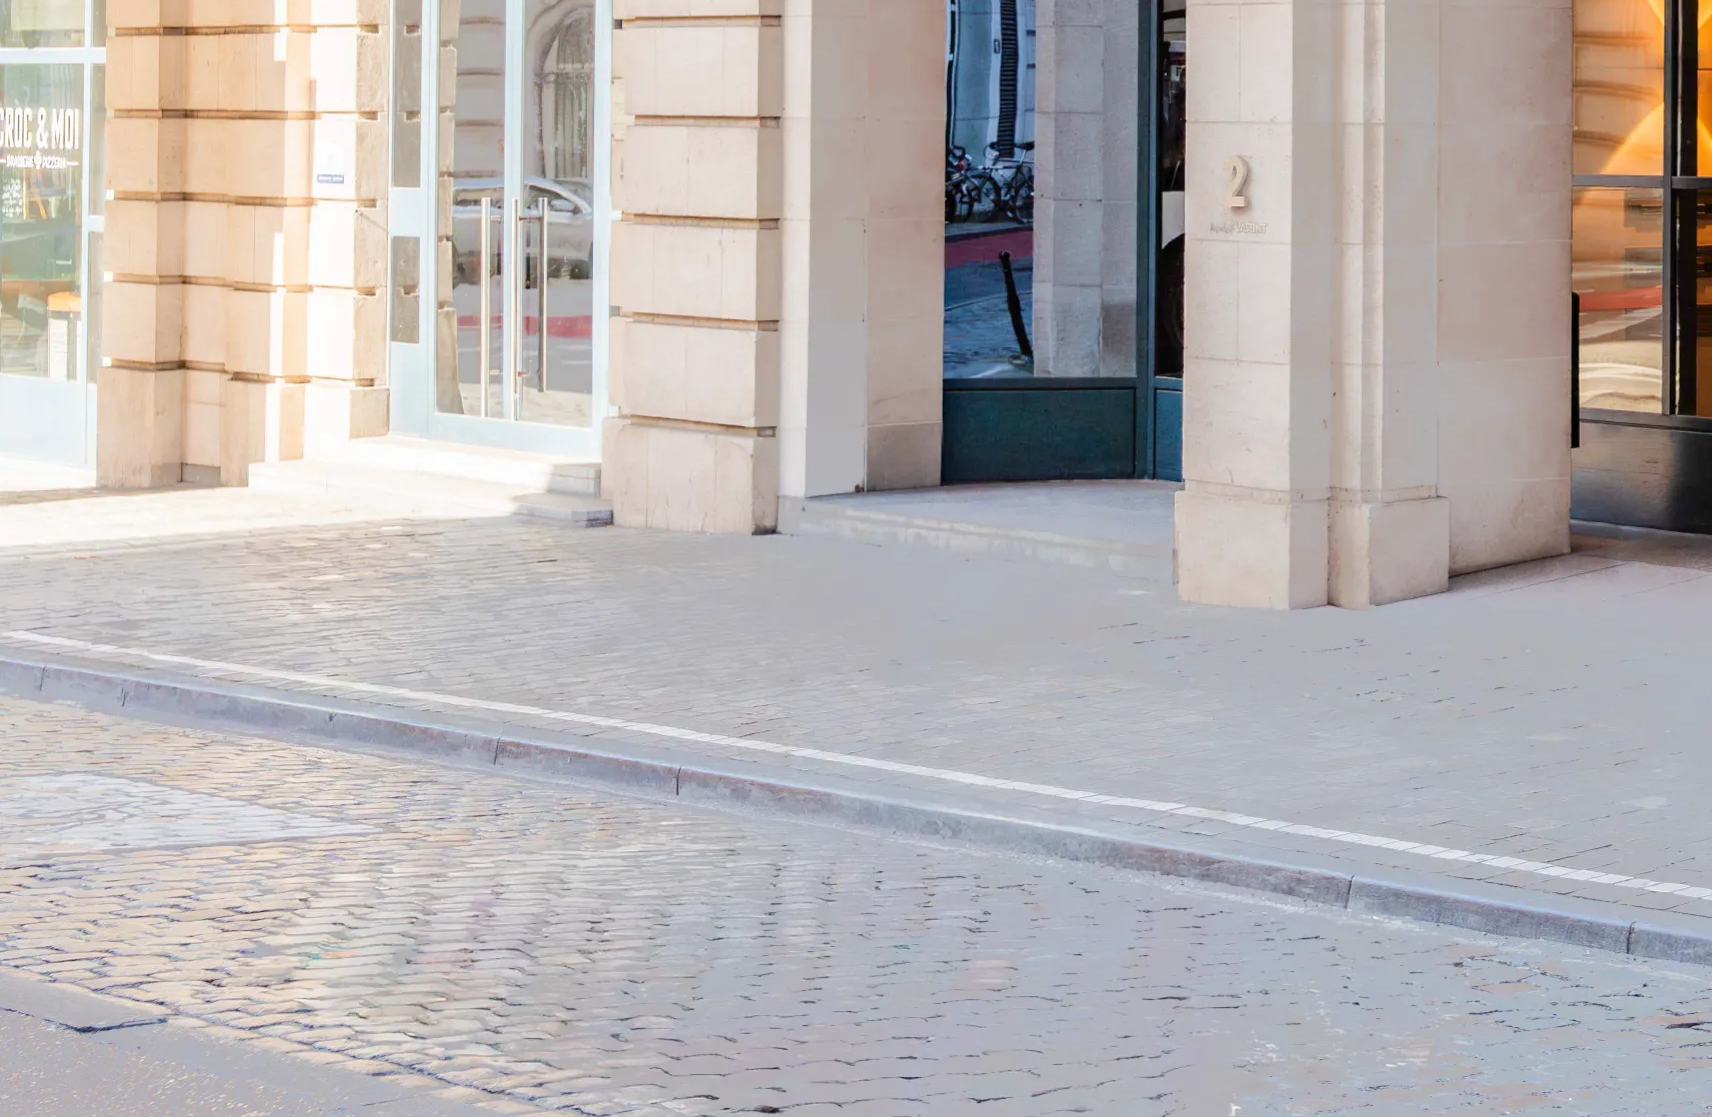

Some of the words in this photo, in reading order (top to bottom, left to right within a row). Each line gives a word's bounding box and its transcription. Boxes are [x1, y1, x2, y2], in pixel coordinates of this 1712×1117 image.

[36, 107, 49, 150] &
[51, 108, 79, 150] MOI
[1222, 155, 1249, 207] 2
